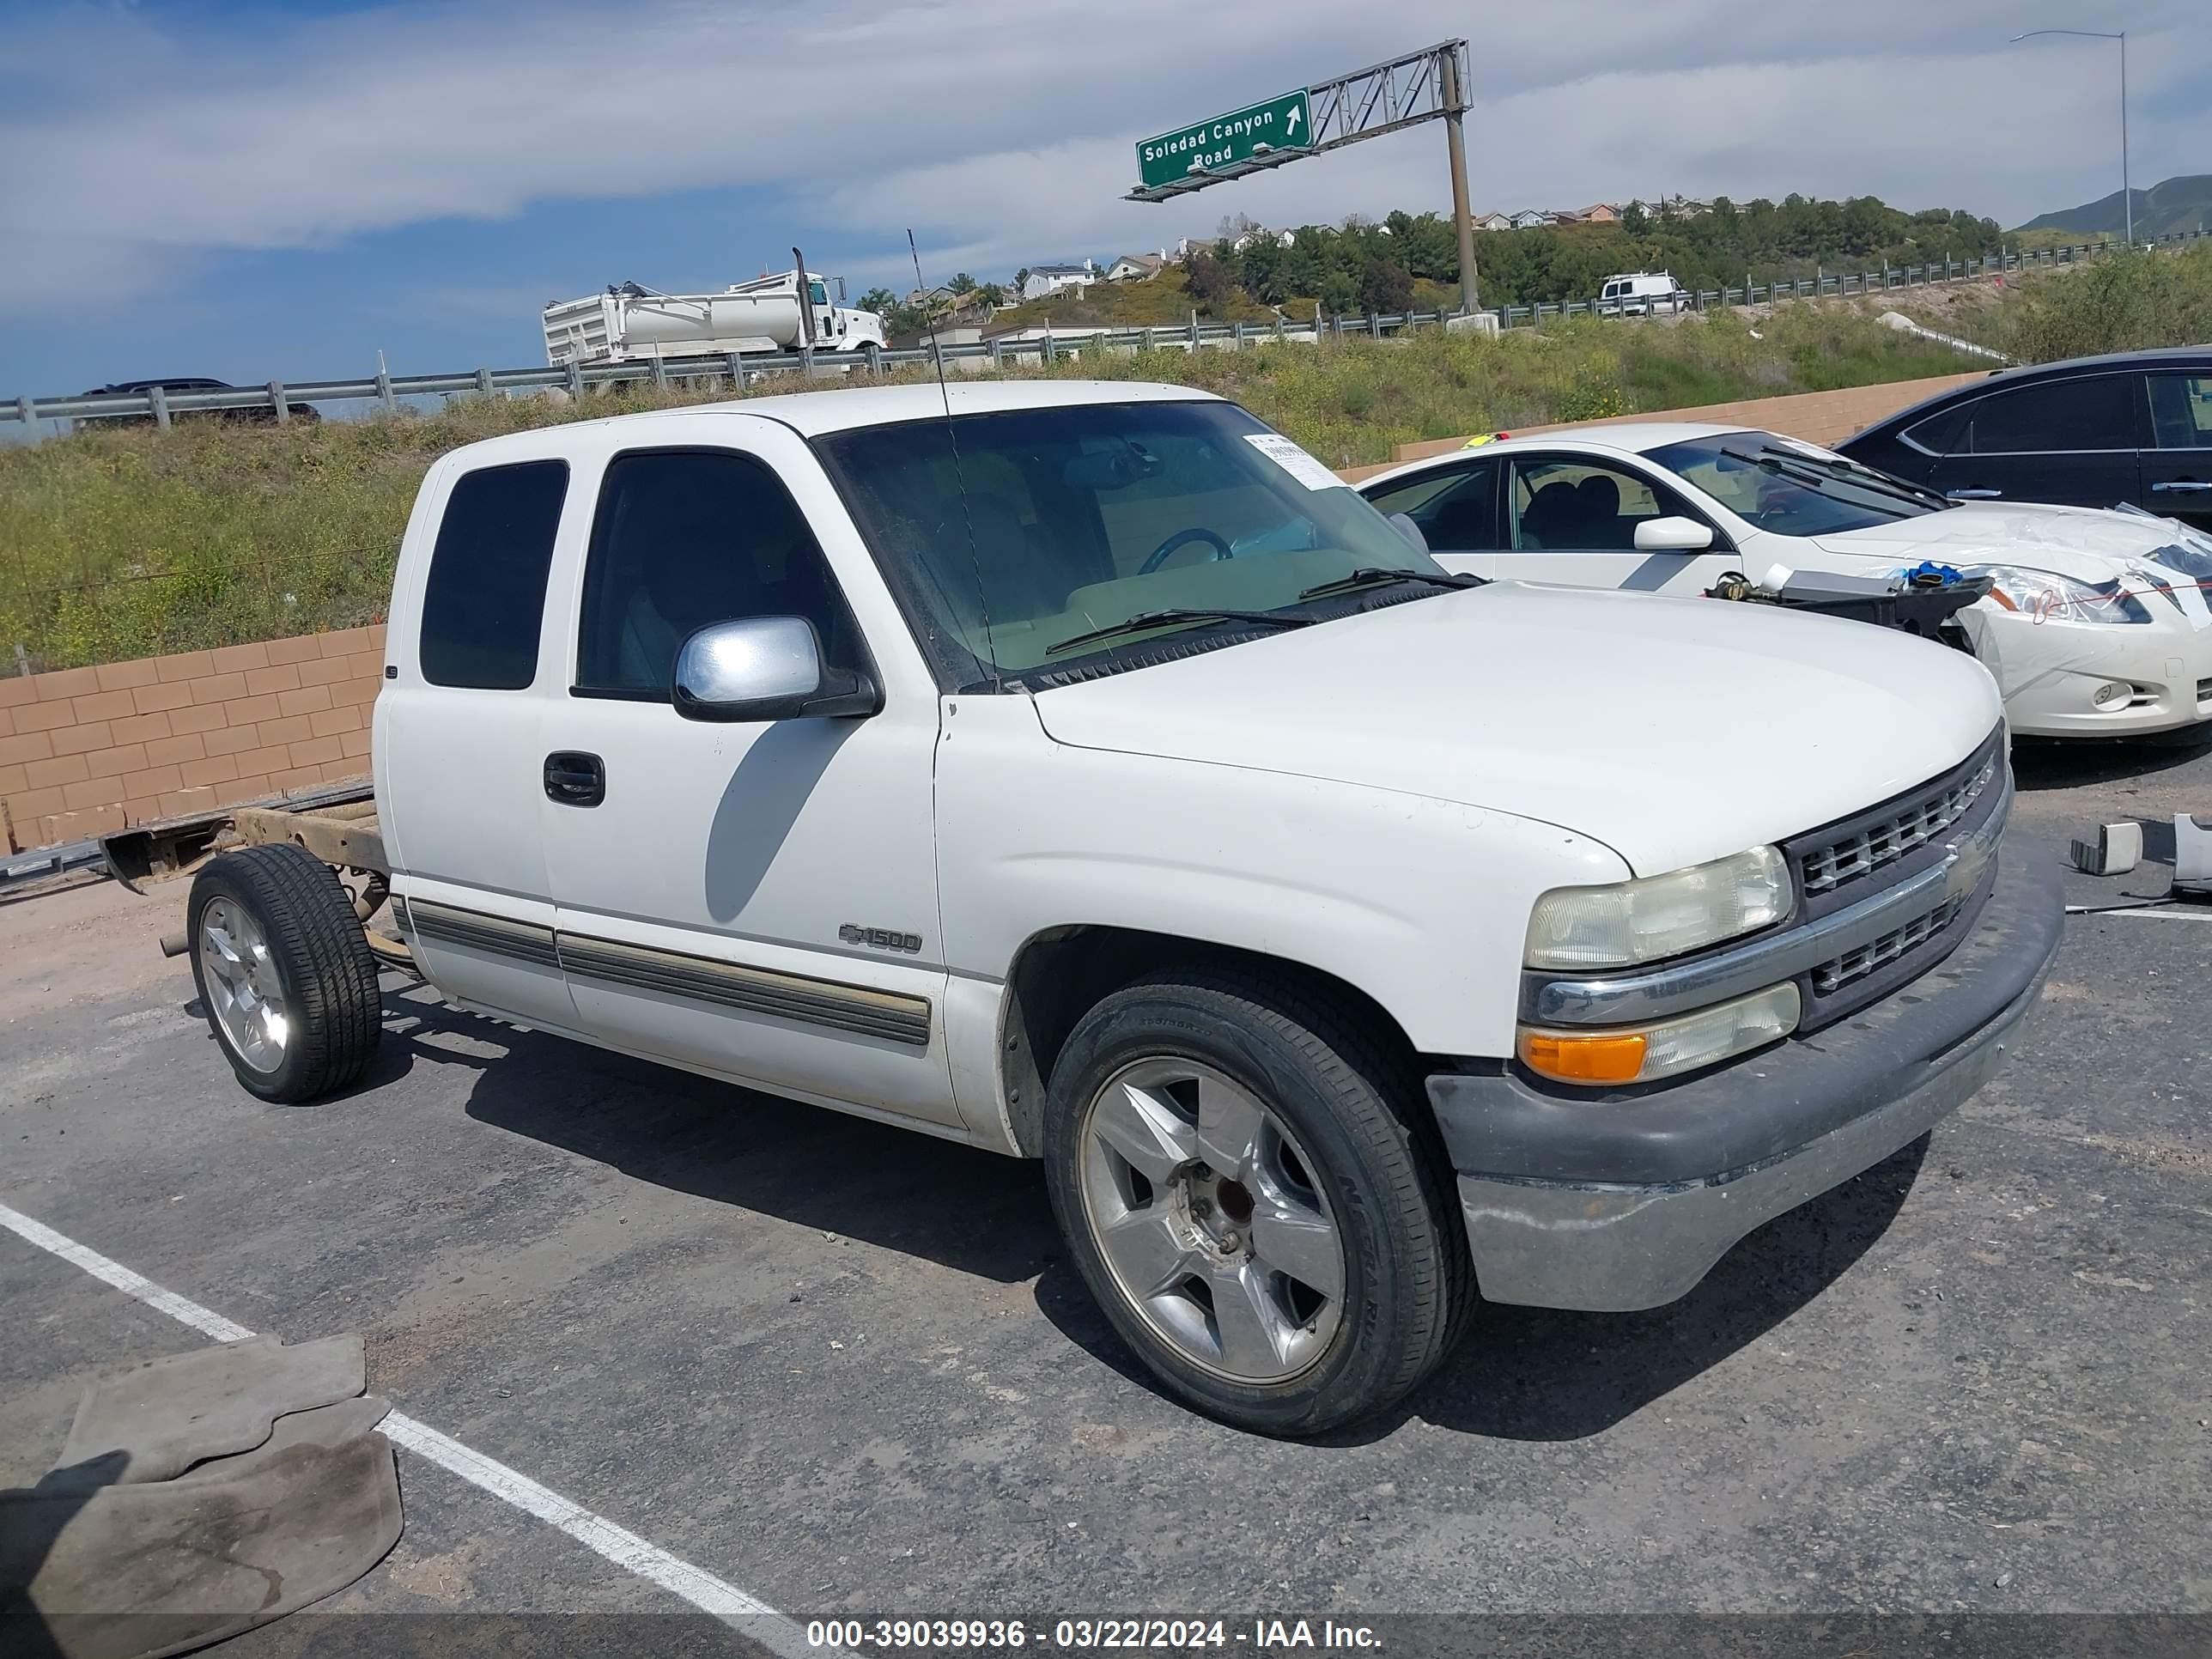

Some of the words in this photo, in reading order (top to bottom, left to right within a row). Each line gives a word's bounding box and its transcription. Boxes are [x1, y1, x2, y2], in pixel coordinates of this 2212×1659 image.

[1145, 130, 1206, 161] Soledad
[1212, 111, 1273, 139] Canyon
[1194, 144, 1232, 167] Road
[866, 927, 923, 954] 1500
